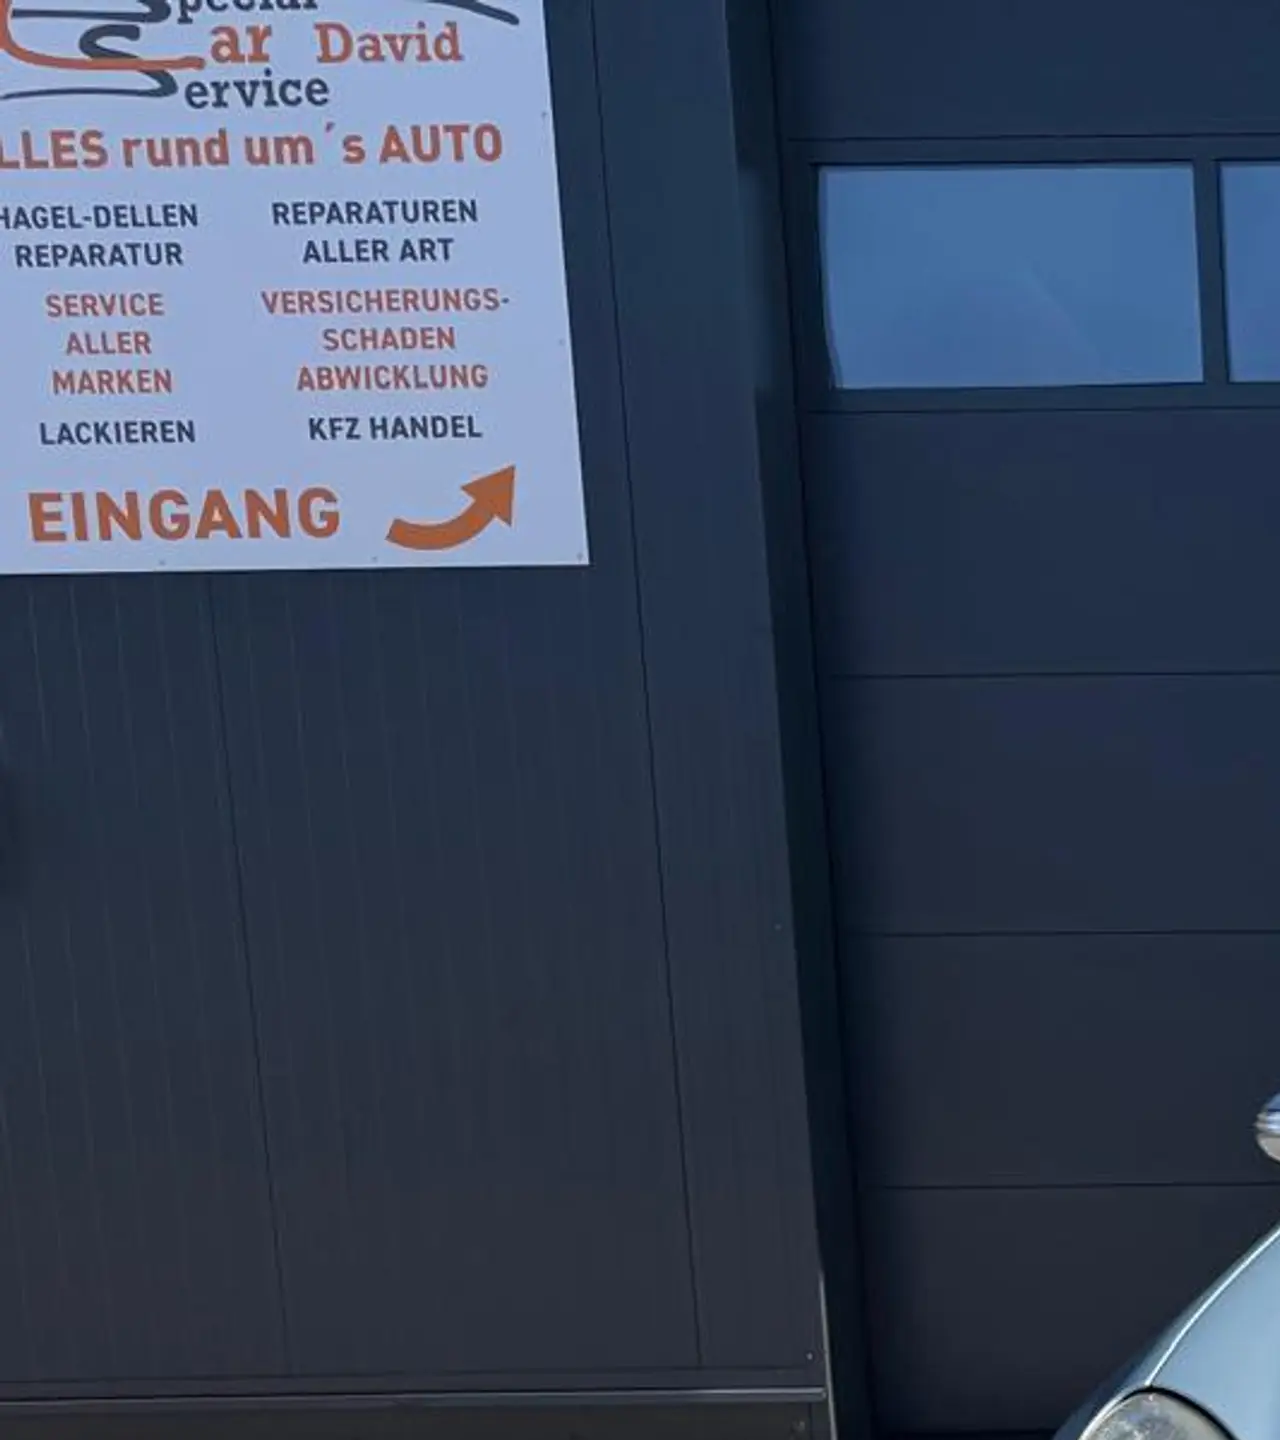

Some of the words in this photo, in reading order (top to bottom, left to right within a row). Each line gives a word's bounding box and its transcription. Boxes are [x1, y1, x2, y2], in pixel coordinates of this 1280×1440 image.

[314, 22, 462, 63] David
[122, 128, 229, 168] rund
[379, 123, 503, 164] AUTO
[272, 199, 479, 226] REPARATUREN
[15, 242, 184, 268] REPARATUR
[302, 239, 390, 264] ALLER
[400, 237, 454, 262] ART
[45, 293, 165, 318] SERVICE
[261, 287, 510, 315] VERSICHERUNGS-
[66, 331, 152, 355] ALLER
[322, 326, 456, 352] SCHADEN
[52, 368, 173, 395] MARKEN
[297, 364, 489, 391] ABWICKLUNG
[39, 419, 196, 446] LACKIEREN
[308, 416, 361, 441] KFZ
[369, 415, 483, 440] HANDEL
[28, 487, 341, 542] EINGANG
